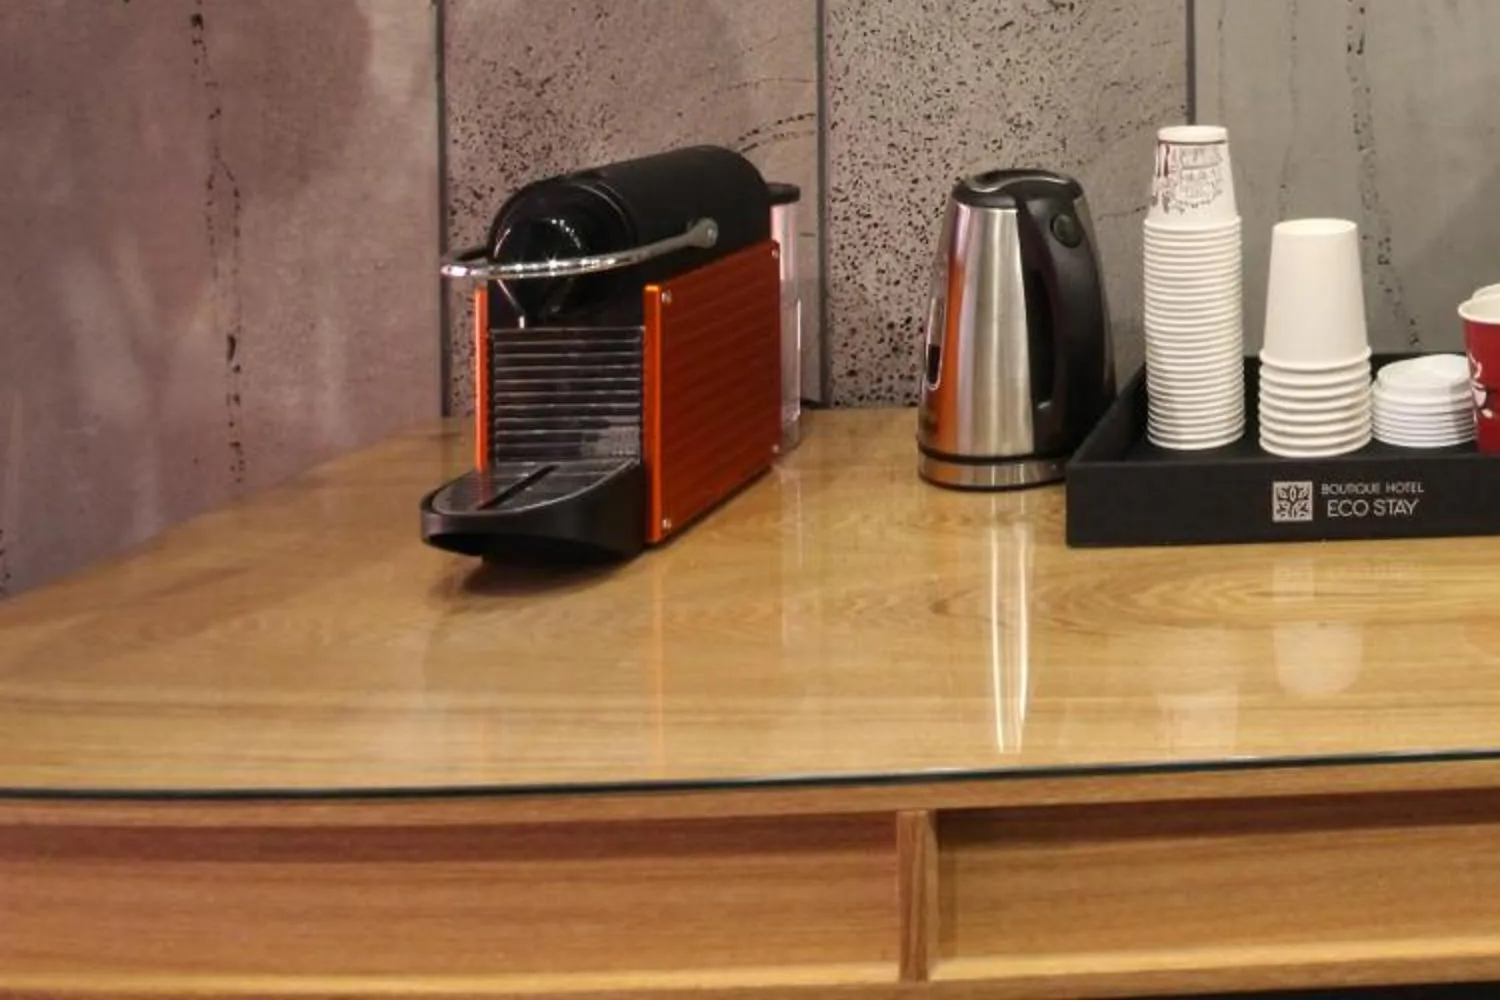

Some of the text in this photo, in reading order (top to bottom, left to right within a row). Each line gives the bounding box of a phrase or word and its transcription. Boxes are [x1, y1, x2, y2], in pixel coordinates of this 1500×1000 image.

[1320, 481, 1424, 495] BOUTIQUE HOTEL
[1327, 498, 1419, 517] ECO STAY
